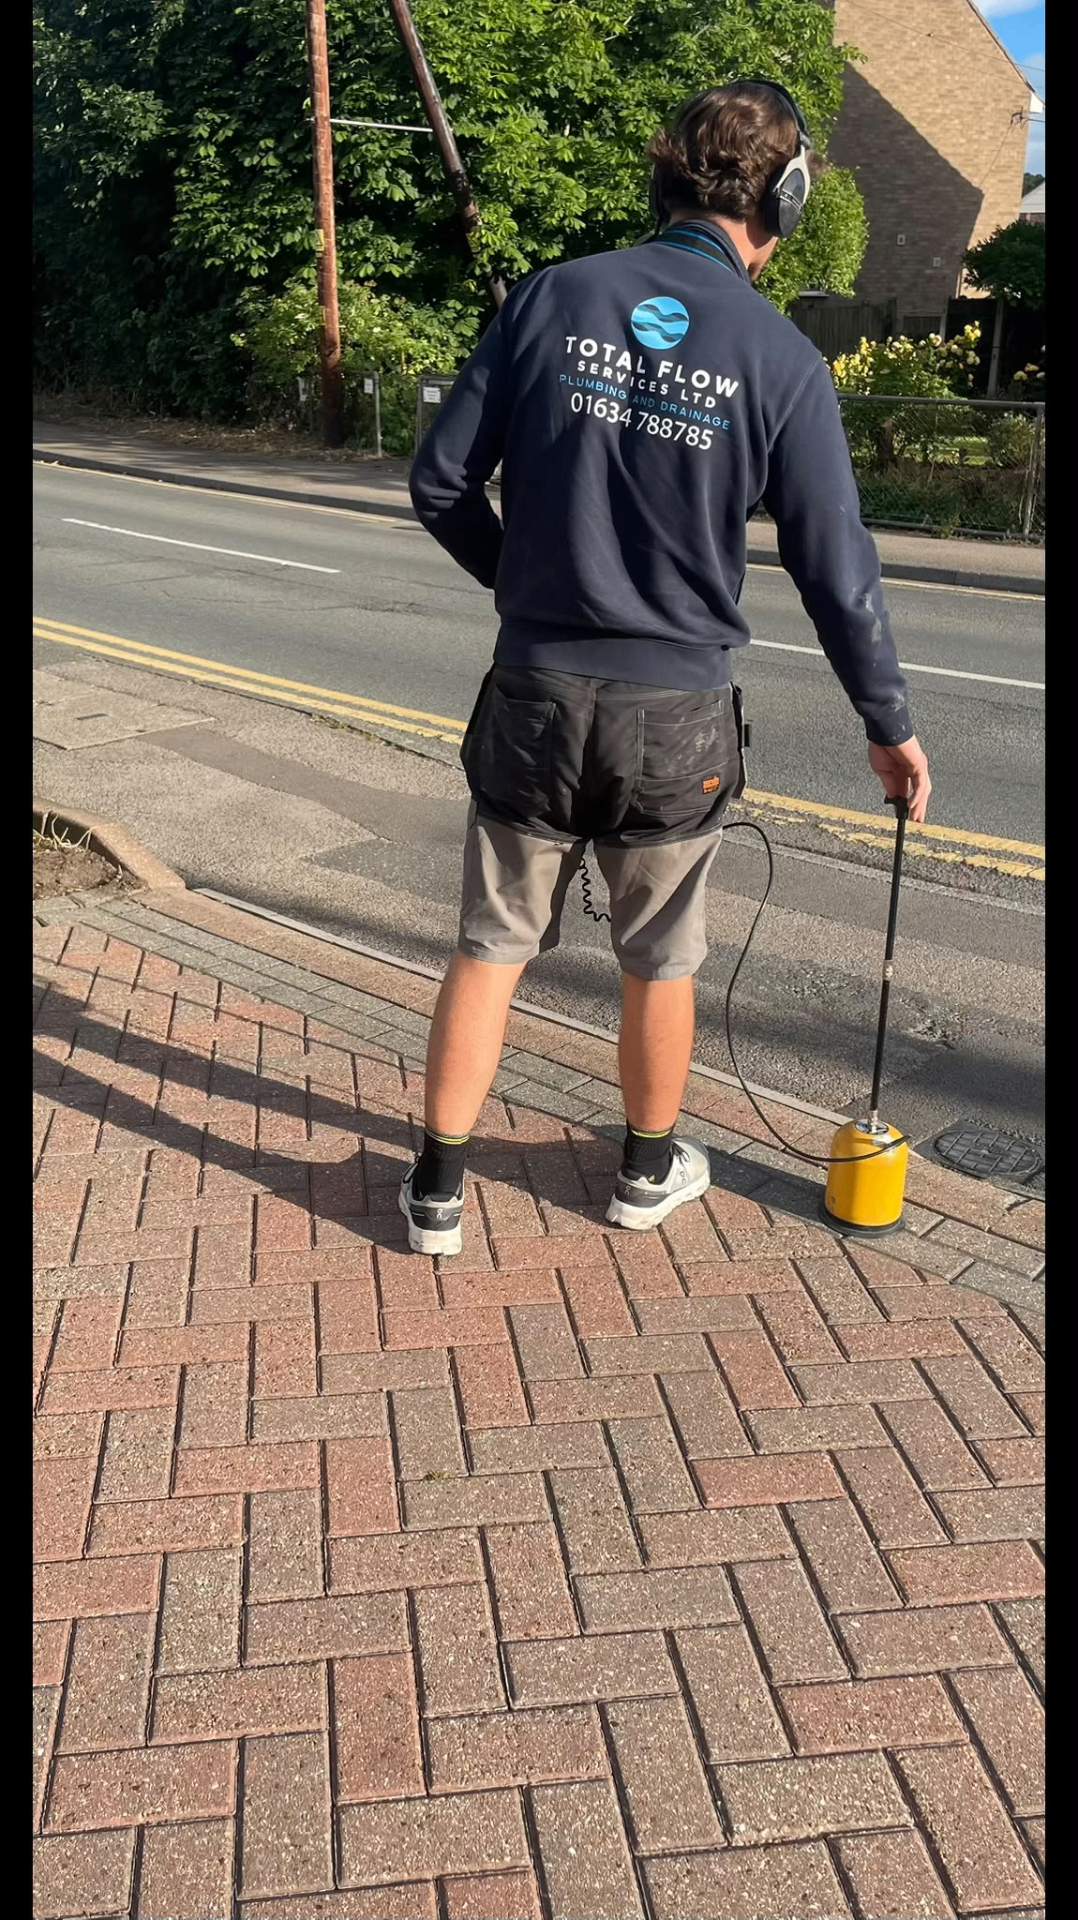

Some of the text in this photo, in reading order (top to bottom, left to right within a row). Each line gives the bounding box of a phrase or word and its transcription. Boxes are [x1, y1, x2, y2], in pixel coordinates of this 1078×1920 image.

[565, 336, 740, 398] TOTAL FLOW
[577, 360, 716, 409] SERVICES LTD
[559, 374, 731, 430] PLUMBING AND DRAINAGE
[571, 392, 714, 451] 01634 788785
